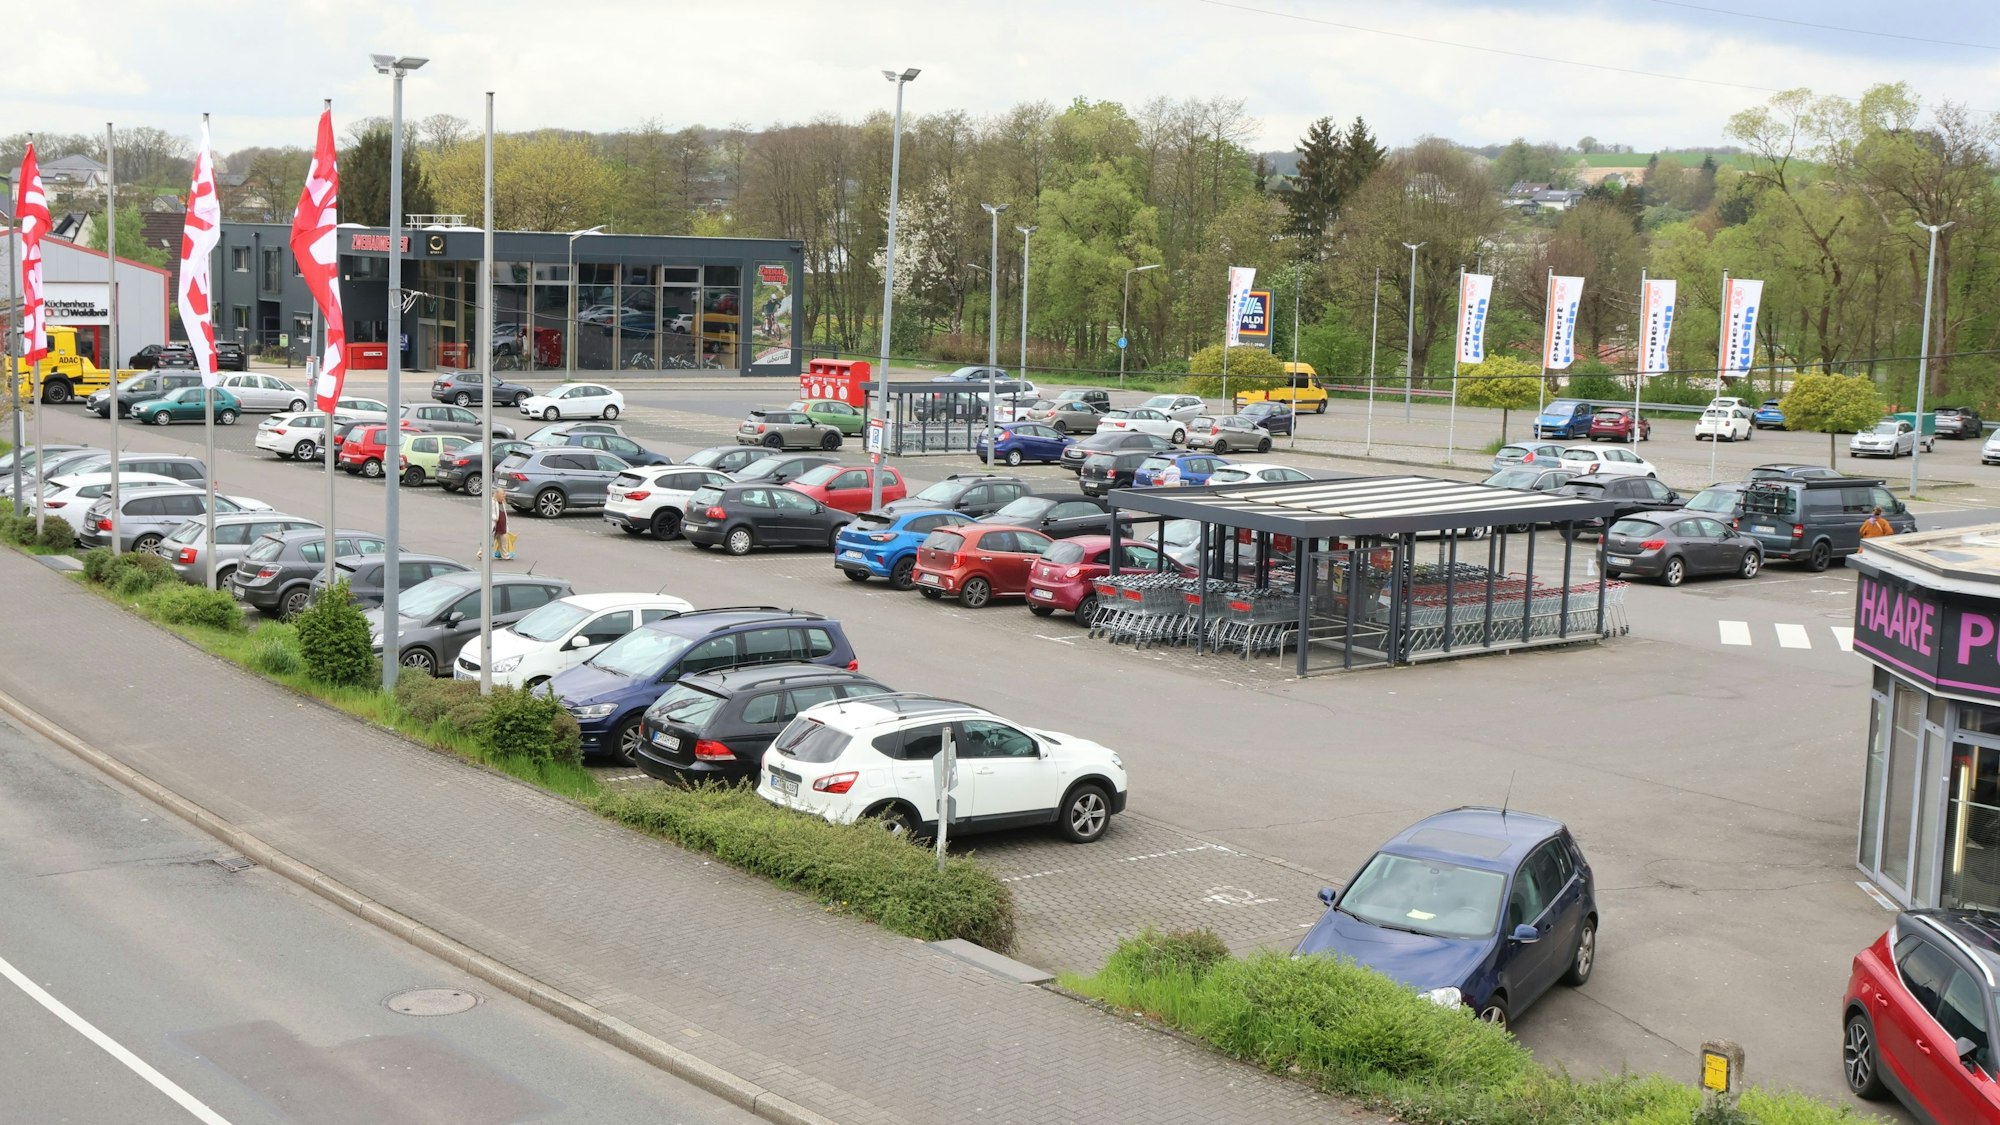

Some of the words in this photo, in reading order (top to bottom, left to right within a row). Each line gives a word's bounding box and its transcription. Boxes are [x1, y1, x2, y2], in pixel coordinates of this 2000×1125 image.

[44, 300, 95, 308] Küchenhaus
[70, 308, 108, 317] Waldbröl
[1242, 316, 1264, 325] ALDI
[1860, 579, 1935, 657] HAARE
[1957, 612, 2000, 666] P
